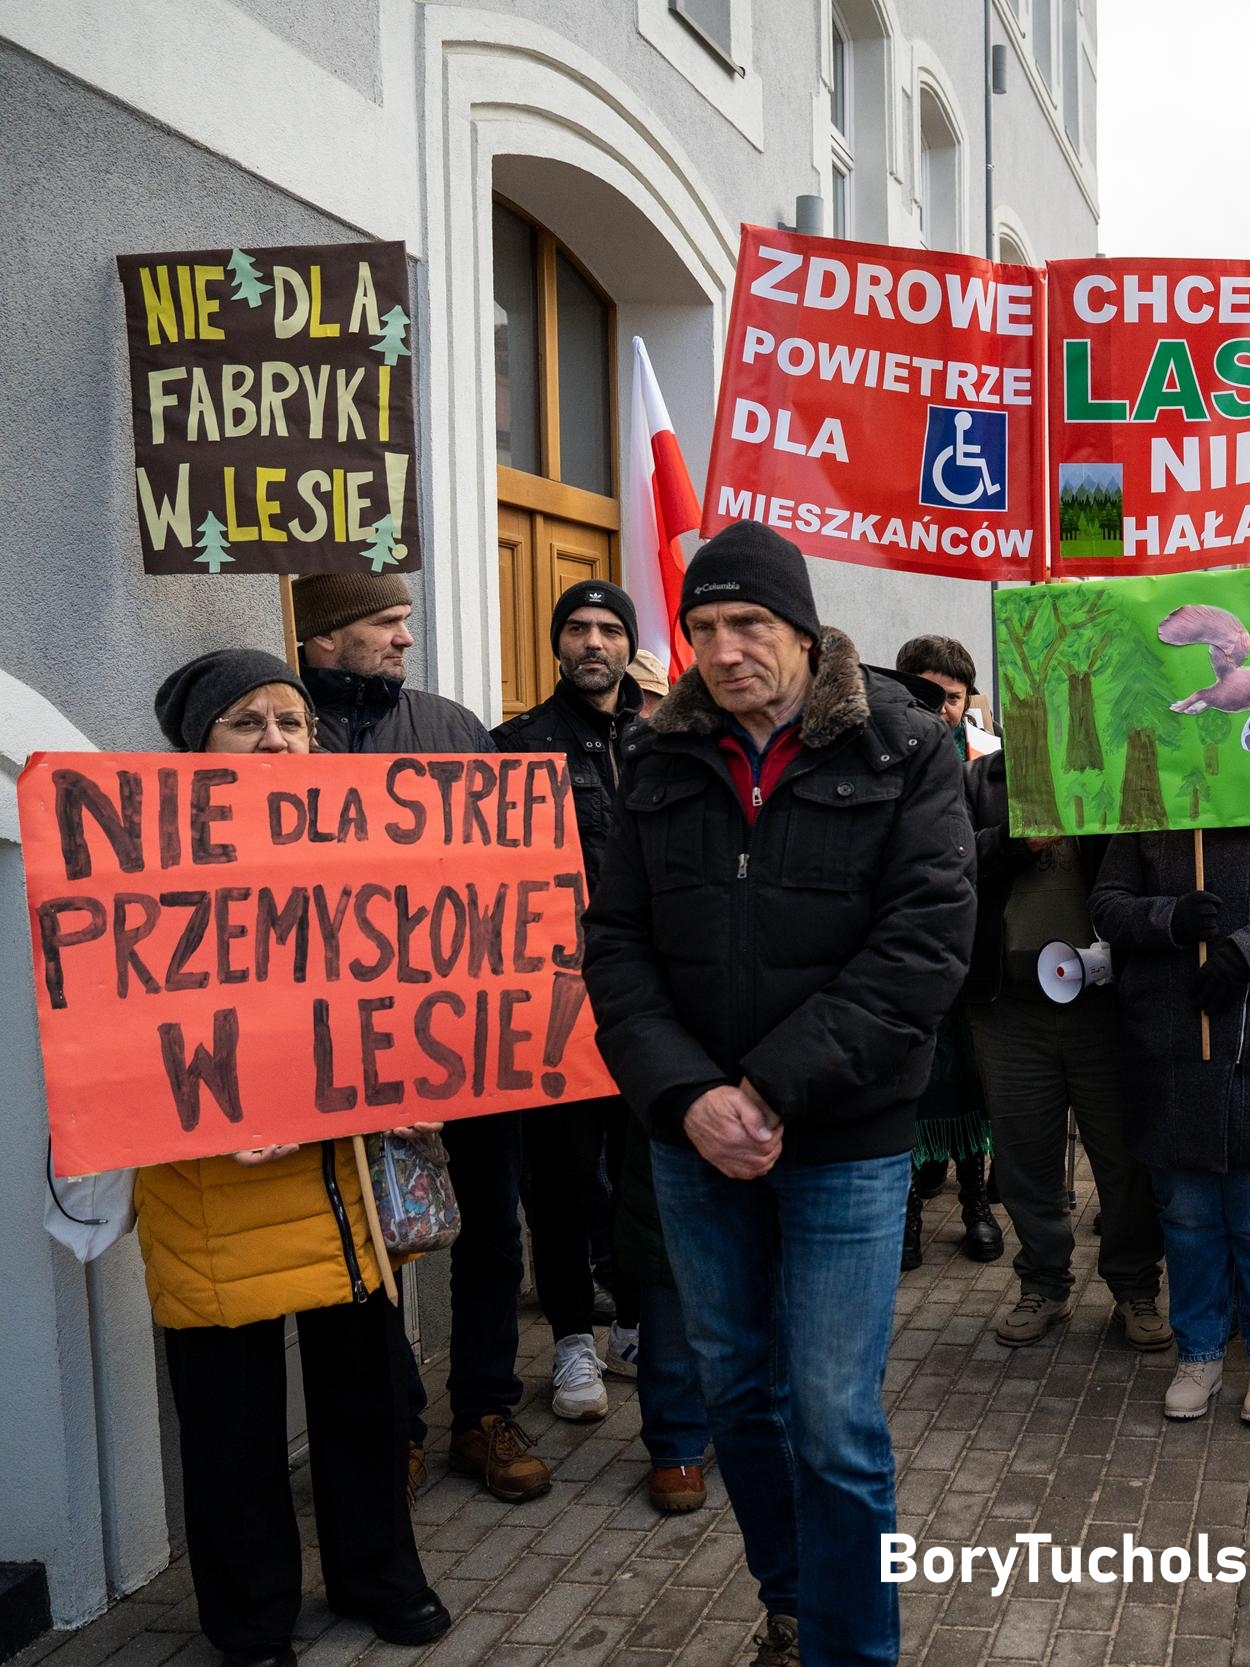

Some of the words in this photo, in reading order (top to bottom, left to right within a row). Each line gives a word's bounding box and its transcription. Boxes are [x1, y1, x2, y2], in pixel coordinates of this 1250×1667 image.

[139, 265, 225, 345] NIE
[273, 261, 381, 339] DLA
[751, 246, 1033, 336] ZDROWE
[149, 364, 391, 444] FABRYKI
[742, 326, 1033, 406] POWIETRZE
[731, 397, 849, 463] DLA
[136, 462, 193, 551] W
[224, 452, 409, 560] LESIE!
[717, 485, 1033, 558] MIESZKAŃCÓW
[702, 581, 740, 592] Columbia
[52, 768, 237, 880] NIE
[268, 788, 368, 844] DLA
[384, 758, 571, 849] STREFY
[37, 871, 585, 1010] PRZEMYSŁOWEJ
[158, 1007, 243, 1132] W
[313, 971, 587, 1113] LESIE!
